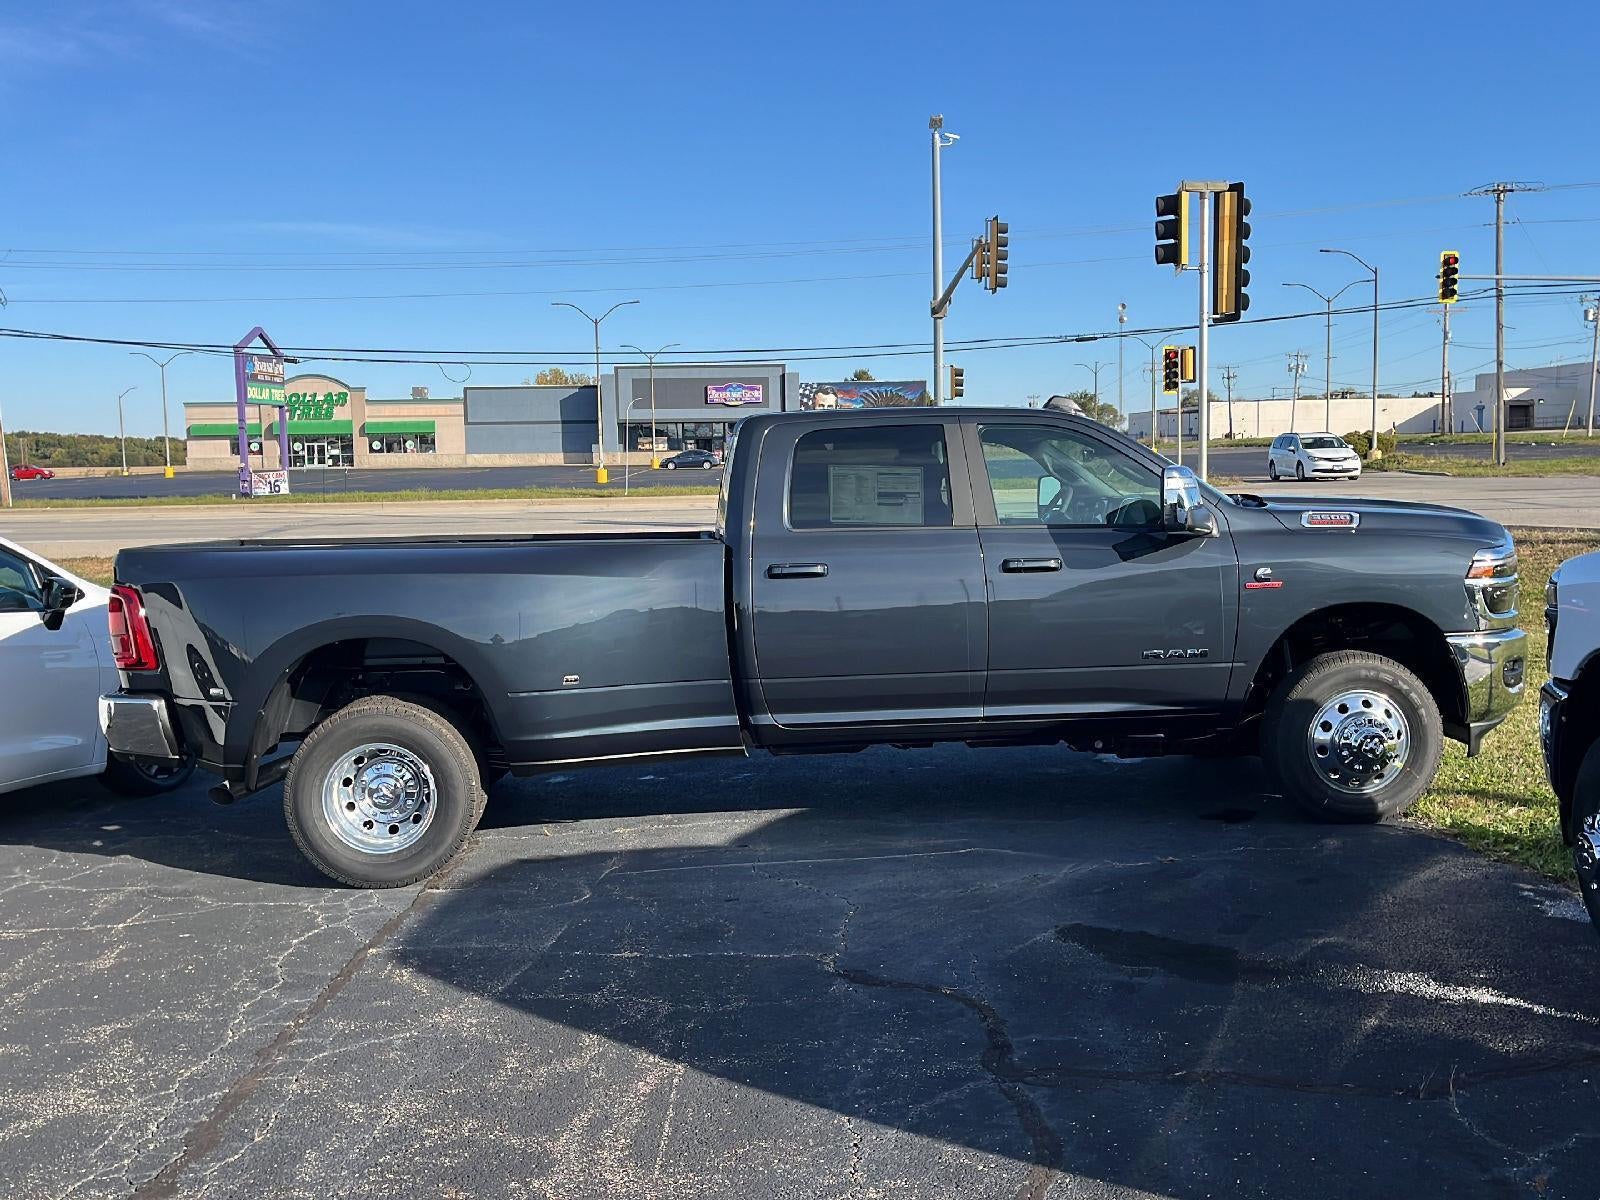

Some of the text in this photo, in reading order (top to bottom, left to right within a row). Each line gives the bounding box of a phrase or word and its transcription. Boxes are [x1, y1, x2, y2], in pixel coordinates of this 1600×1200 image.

[247, 386, 285, 402] DOLLAR TREE
[285, 391, 349, 407] OLLAR
[287, 405, 335, 420] TREE
[1142, 648, 1209, 660] RAM
